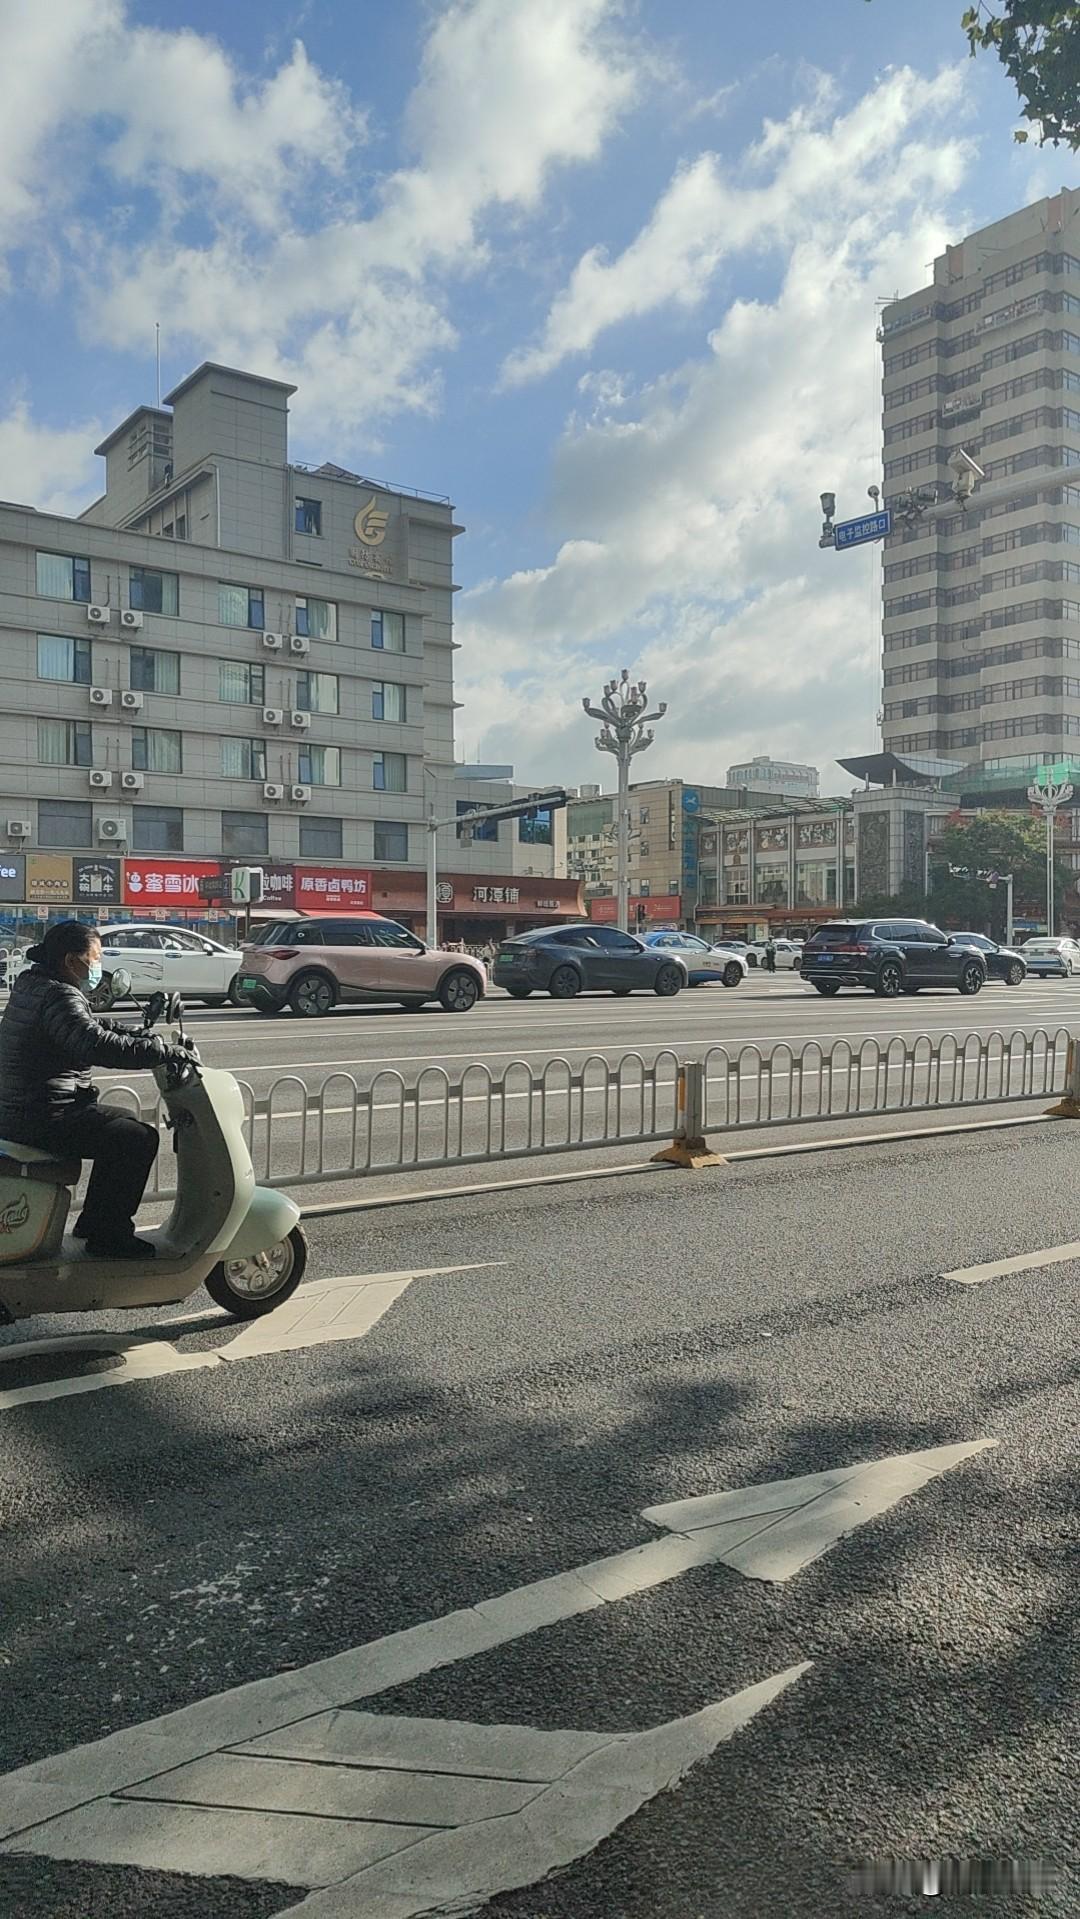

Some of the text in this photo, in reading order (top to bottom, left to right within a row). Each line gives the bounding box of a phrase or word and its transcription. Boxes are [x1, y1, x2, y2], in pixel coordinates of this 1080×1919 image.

[839, 519, 886, 541] 电子监控路口
[0, 865, 16, 878] ee
[144, 873, 216, 893] 蜜雪冰
[301, 877, 367, 894] 原香卤鸭坊
